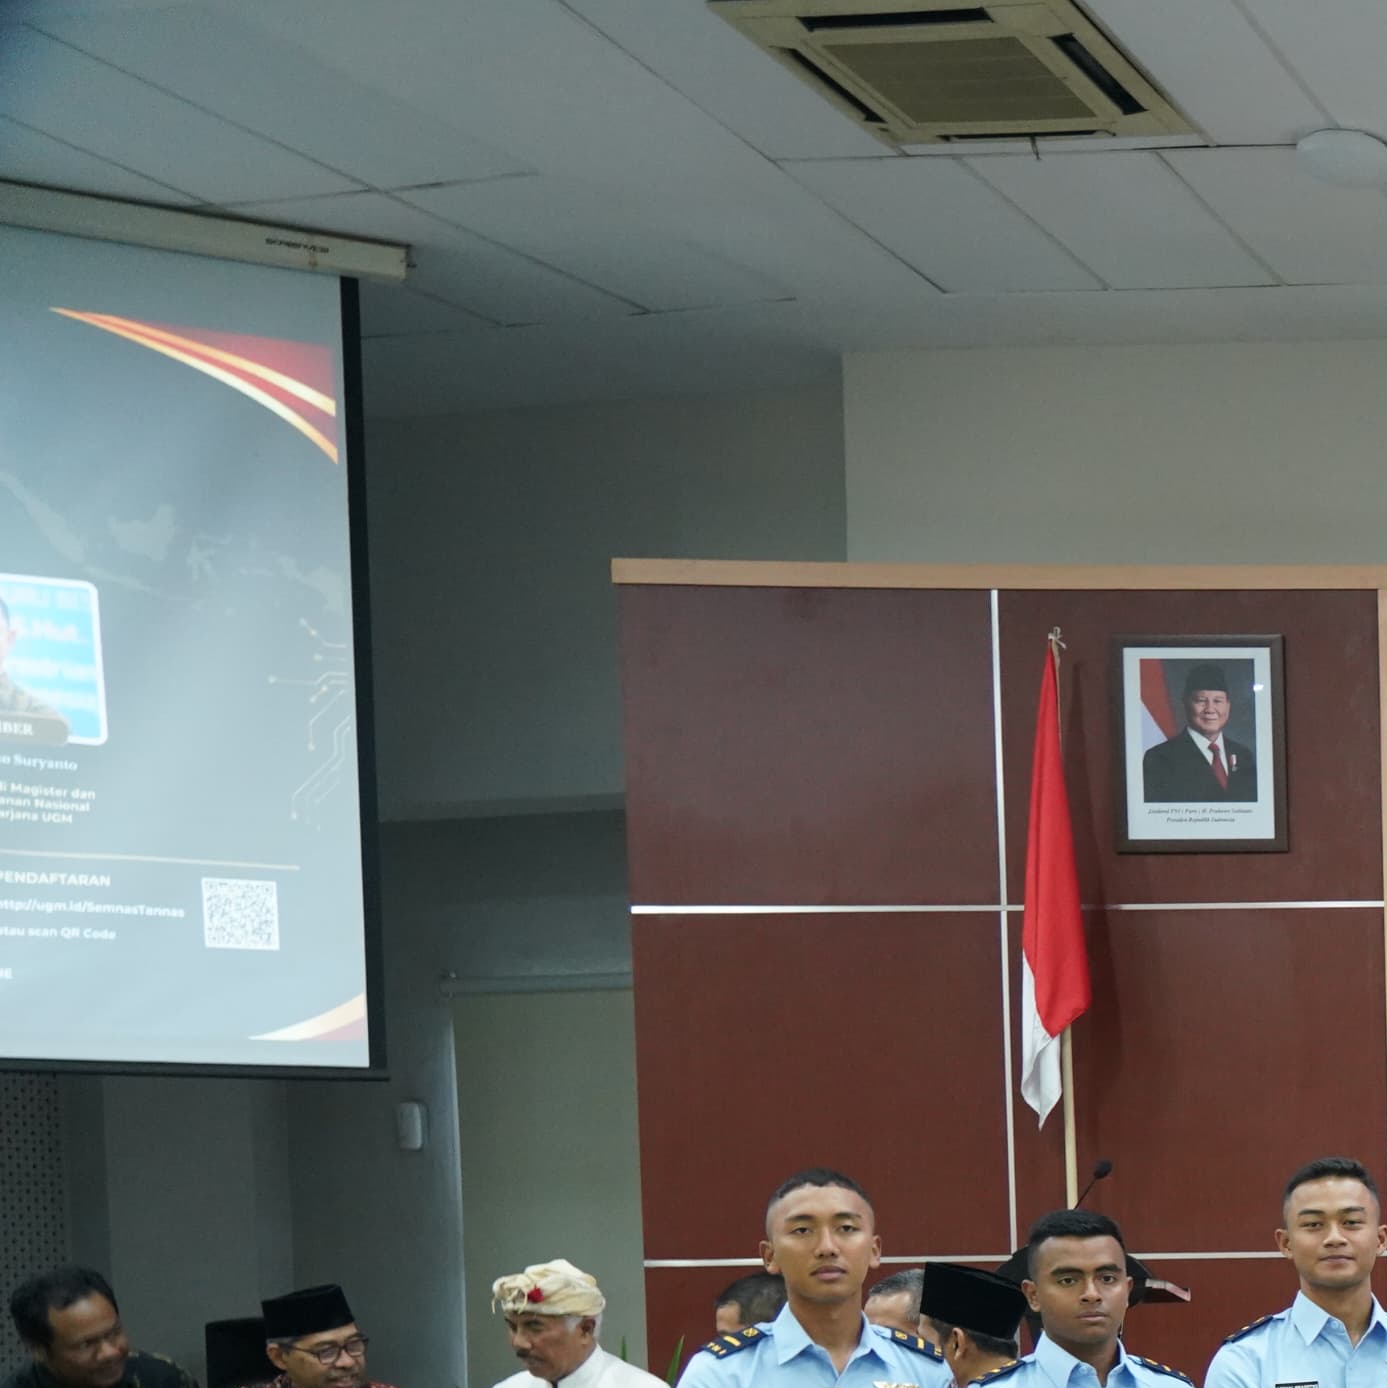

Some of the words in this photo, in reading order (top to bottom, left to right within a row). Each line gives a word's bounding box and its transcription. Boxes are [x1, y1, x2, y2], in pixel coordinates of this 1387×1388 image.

[13, 754, 78, 771] Suryanto
[10, 783, 67, 797] Magister
[71, 788, 95, 800] dan
[35, 799, 90, 812] Nasional
[42, 812, 73, 823] UGM
[28, 928, 57, 937] scan
[61, 927, 79, 939] QR
[84, 929, 116, 939] Code
